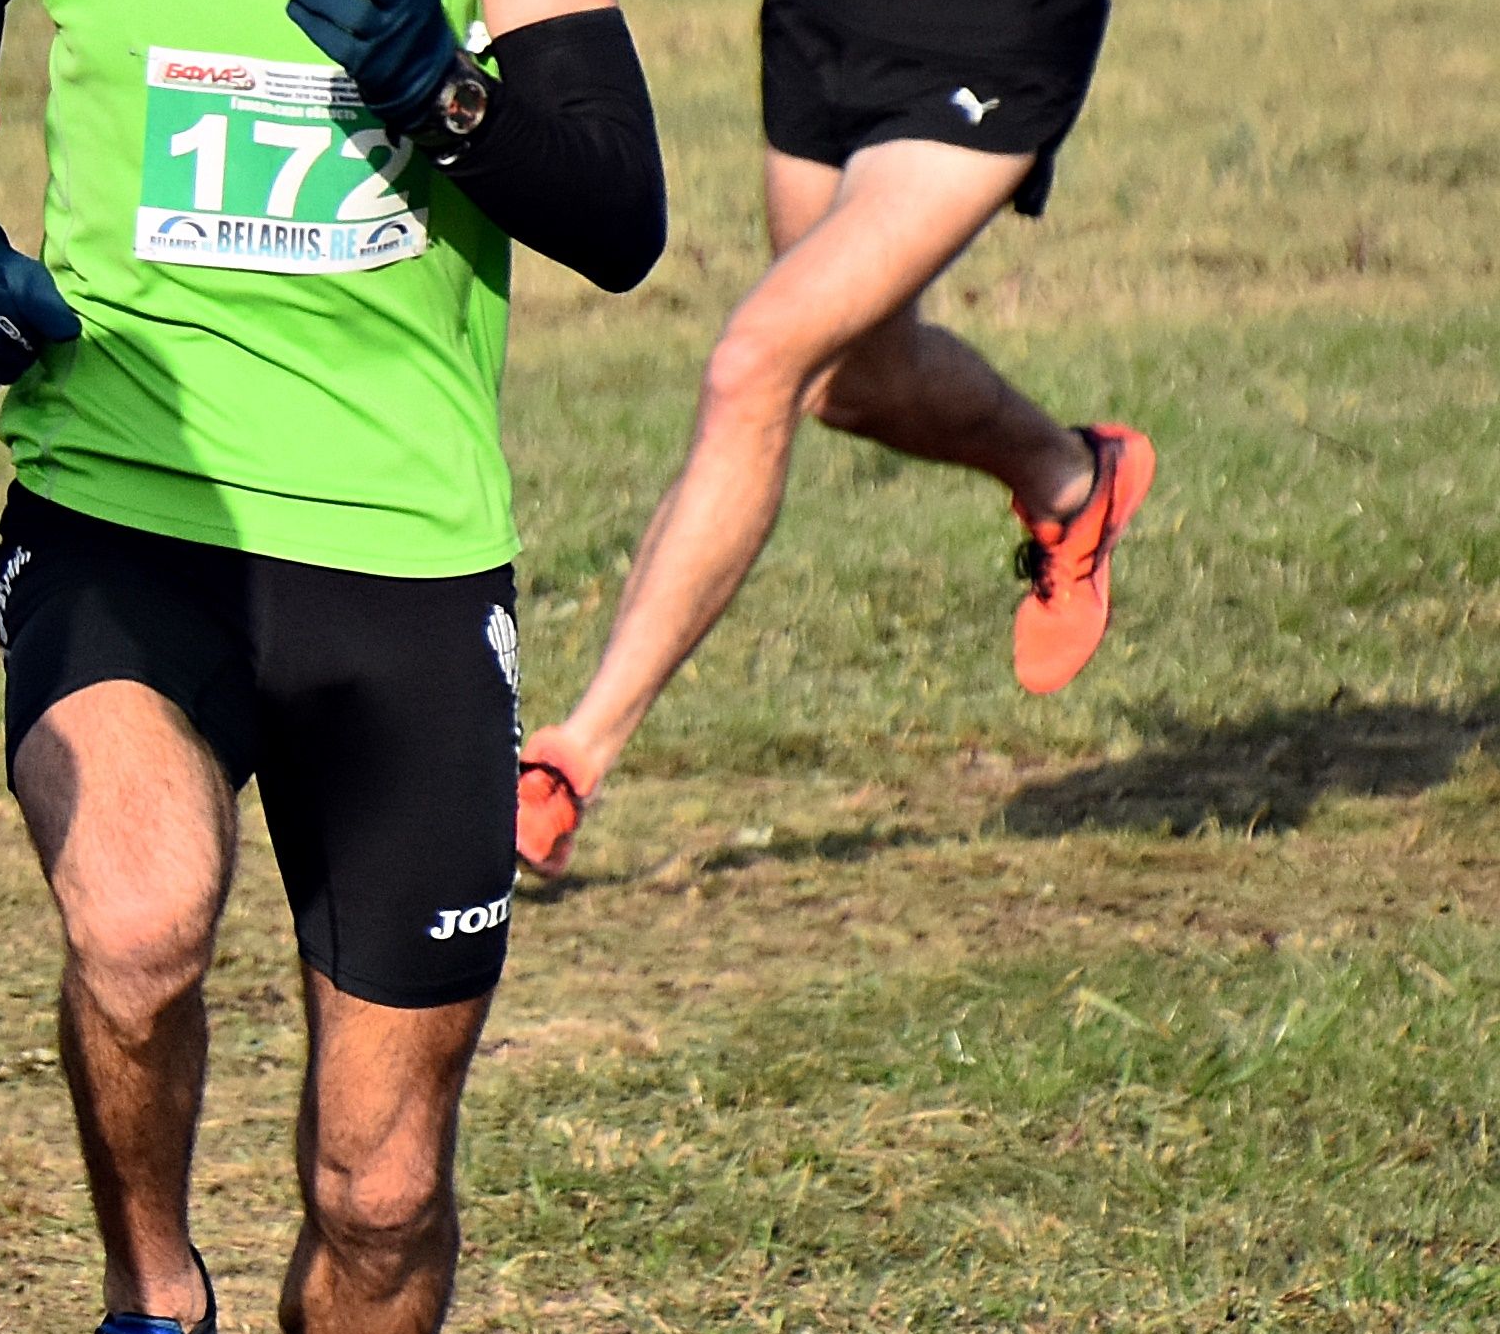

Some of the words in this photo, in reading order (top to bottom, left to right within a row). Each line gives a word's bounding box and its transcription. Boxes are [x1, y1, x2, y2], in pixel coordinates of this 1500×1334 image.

[170, 114, 413, 221] 172
[217, 220, 321, 261] BELARUS
[329, 228, 358, 261] RE
